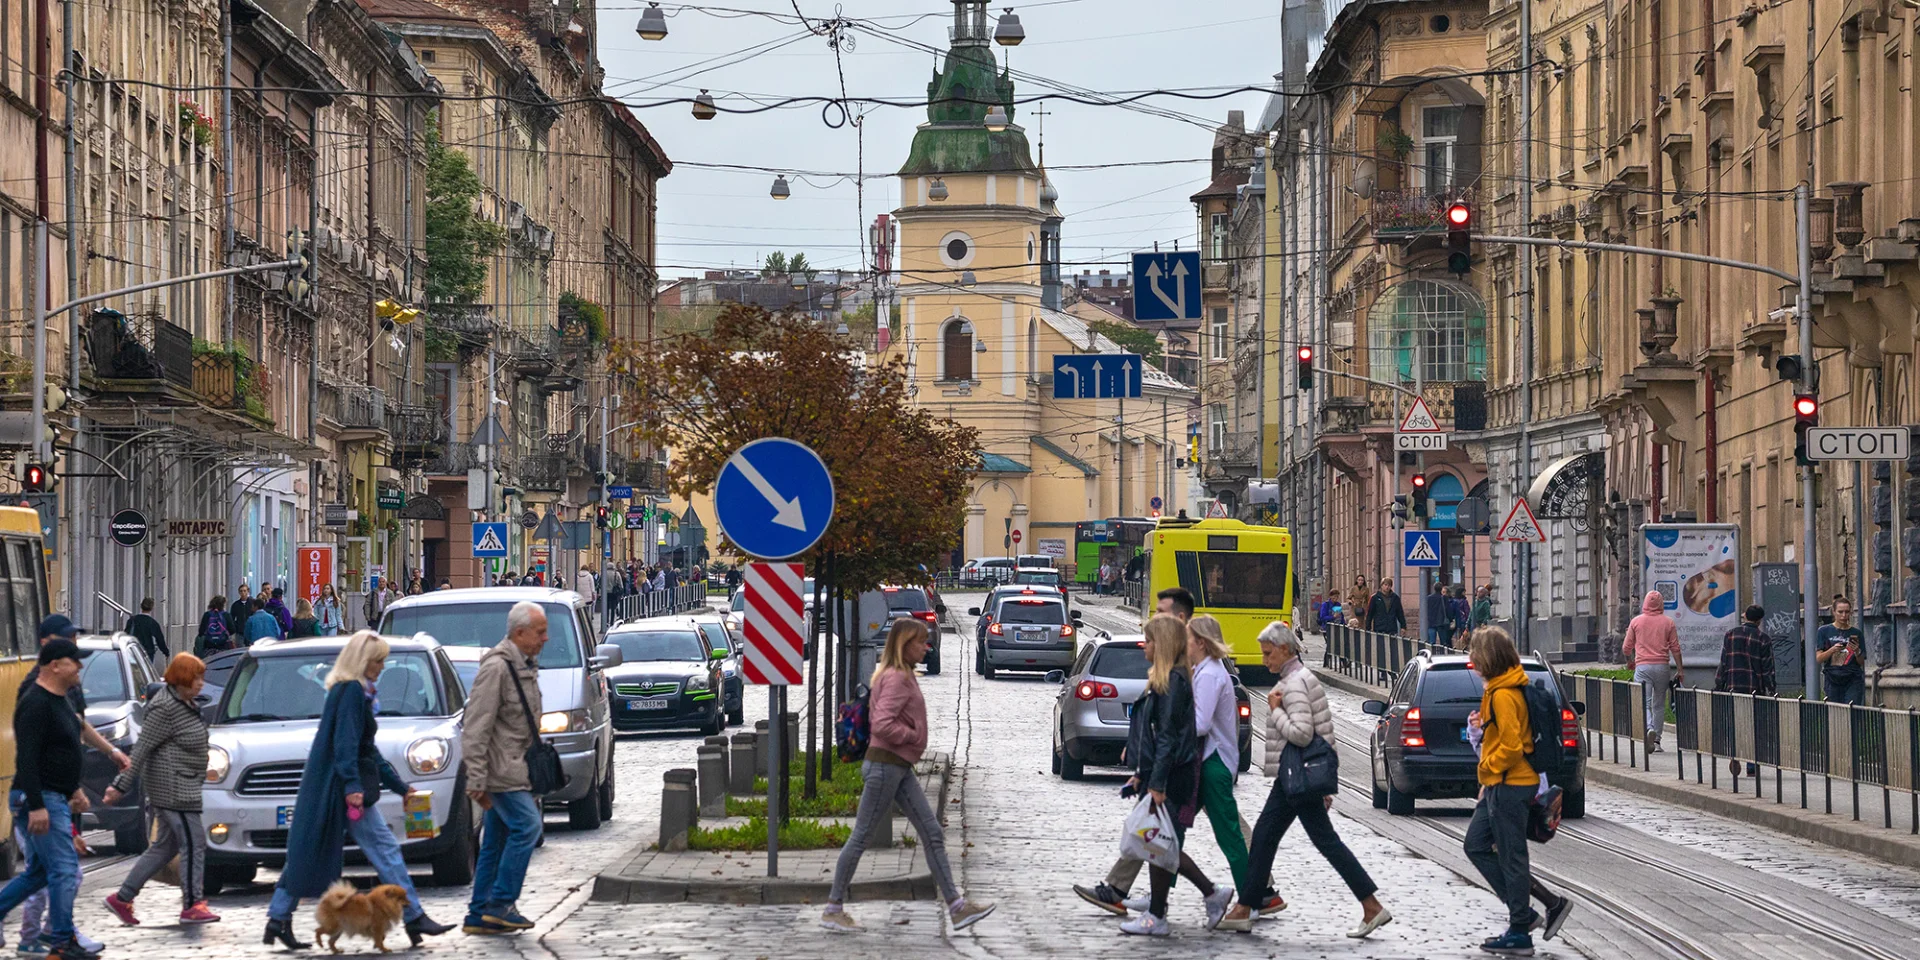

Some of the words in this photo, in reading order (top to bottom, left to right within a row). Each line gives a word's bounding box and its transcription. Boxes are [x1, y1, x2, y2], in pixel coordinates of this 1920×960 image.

[1399, 436, 1442, 448] СТОП
[1819, 433, 1897, 454] СТОП
[610, 488, 630, 496] АРІУС
[169, 521, 225, 535] НОТАРІУС
[310, 550, 320, 607] ОПТИК
[1690, 643, 1722, 651] ЗДОРОВ'
